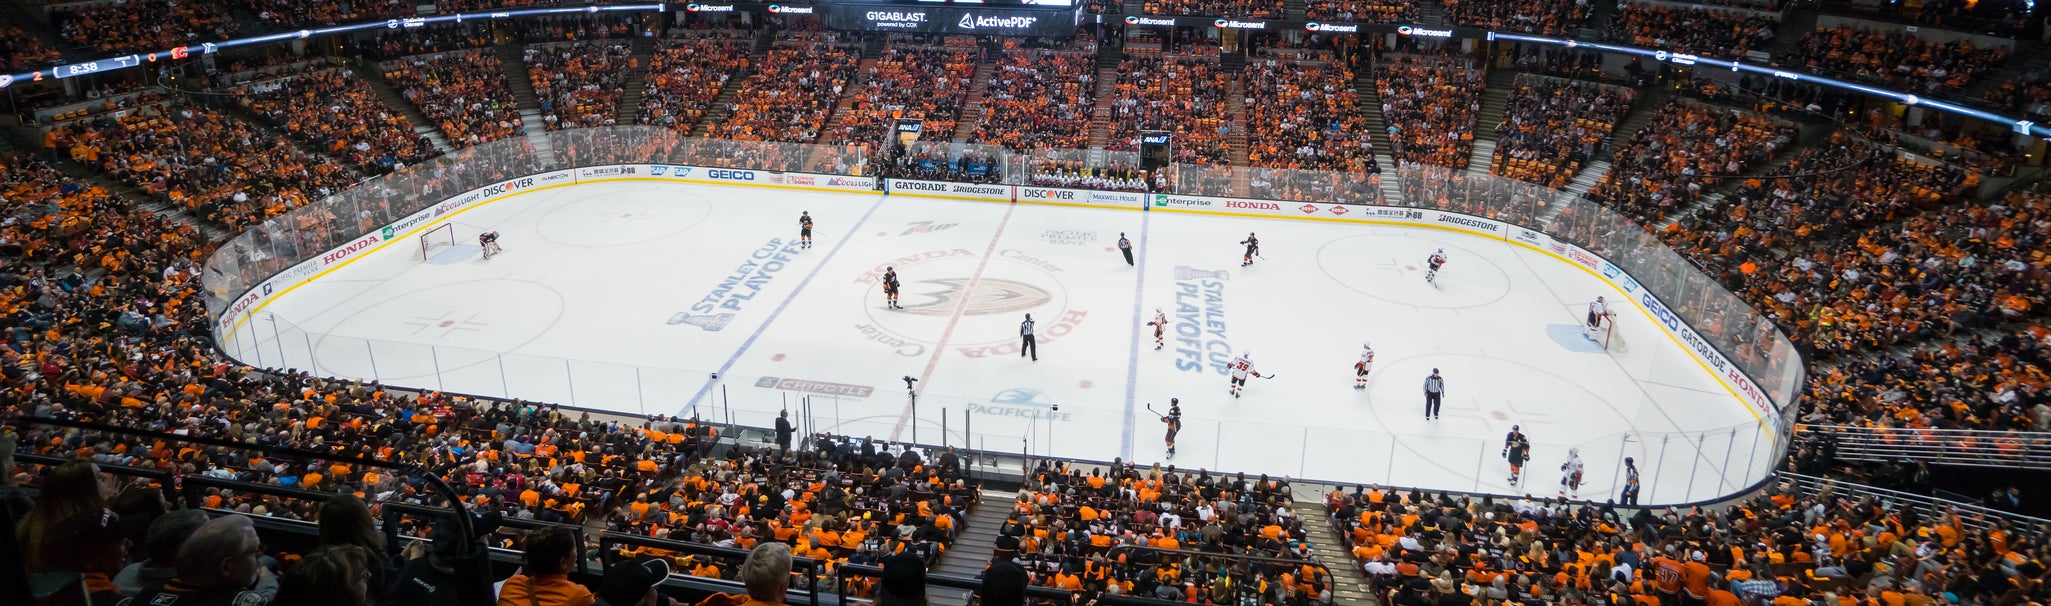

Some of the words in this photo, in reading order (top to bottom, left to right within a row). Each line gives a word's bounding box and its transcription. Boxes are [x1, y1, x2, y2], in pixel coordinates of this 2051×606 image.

[700, 4, 733, 12] Microsemi
[780, 6, 812, 14] Microsemi
[1139, 18, 1175, 26] Microsemi
[1228, 21, 1265, 29] Microsemi
[1320, 24, 1357, 32] Microsemi
[1412, 28, 1452, 37] Microsemi
[70, 62, 98, 74] 8:38
[32, 71, 42, 82] 2
[708, 169, 755, 181] GEICO
[895, 181, 947, 192] GATORADE
[953, 185, 1005, 196] BRIDGESTONE
[461, 193, 481, 206] LIGHT
[1225, 200, 1281, 211] HONDA
[1438, 213, 1499, 232] BRIDGESTONE
[322, 235, 379, 265] HONDA
[691, 259, 758, 314] STANLEY
[751, 236, 784, 259] CUP
[719, 238, 802, 312] PLAYOFFS
[853, 248, 977, 286] HONDA
[1000, 249, 1065, 274] Center
[222, 292, 260, 329] HONDA
[1201, 279, 1227, 340] STANLEY
[1642, 293, 1679, 332] GEICO
[1175, 281, 1203, 374] PLAYOFFS
[1205, 339, 1232, 376] CUP
[1681, 328, 1727, 373] GATORADE
[1236, 361, 1249, 372] 39
[792, 380, 879, 396] CHIPOTLE
[1728, 368, 1771, 418] HONDA
[966, 402, 1032, 419] PACIFIC
[1658, 567, 1678, 584] 47
